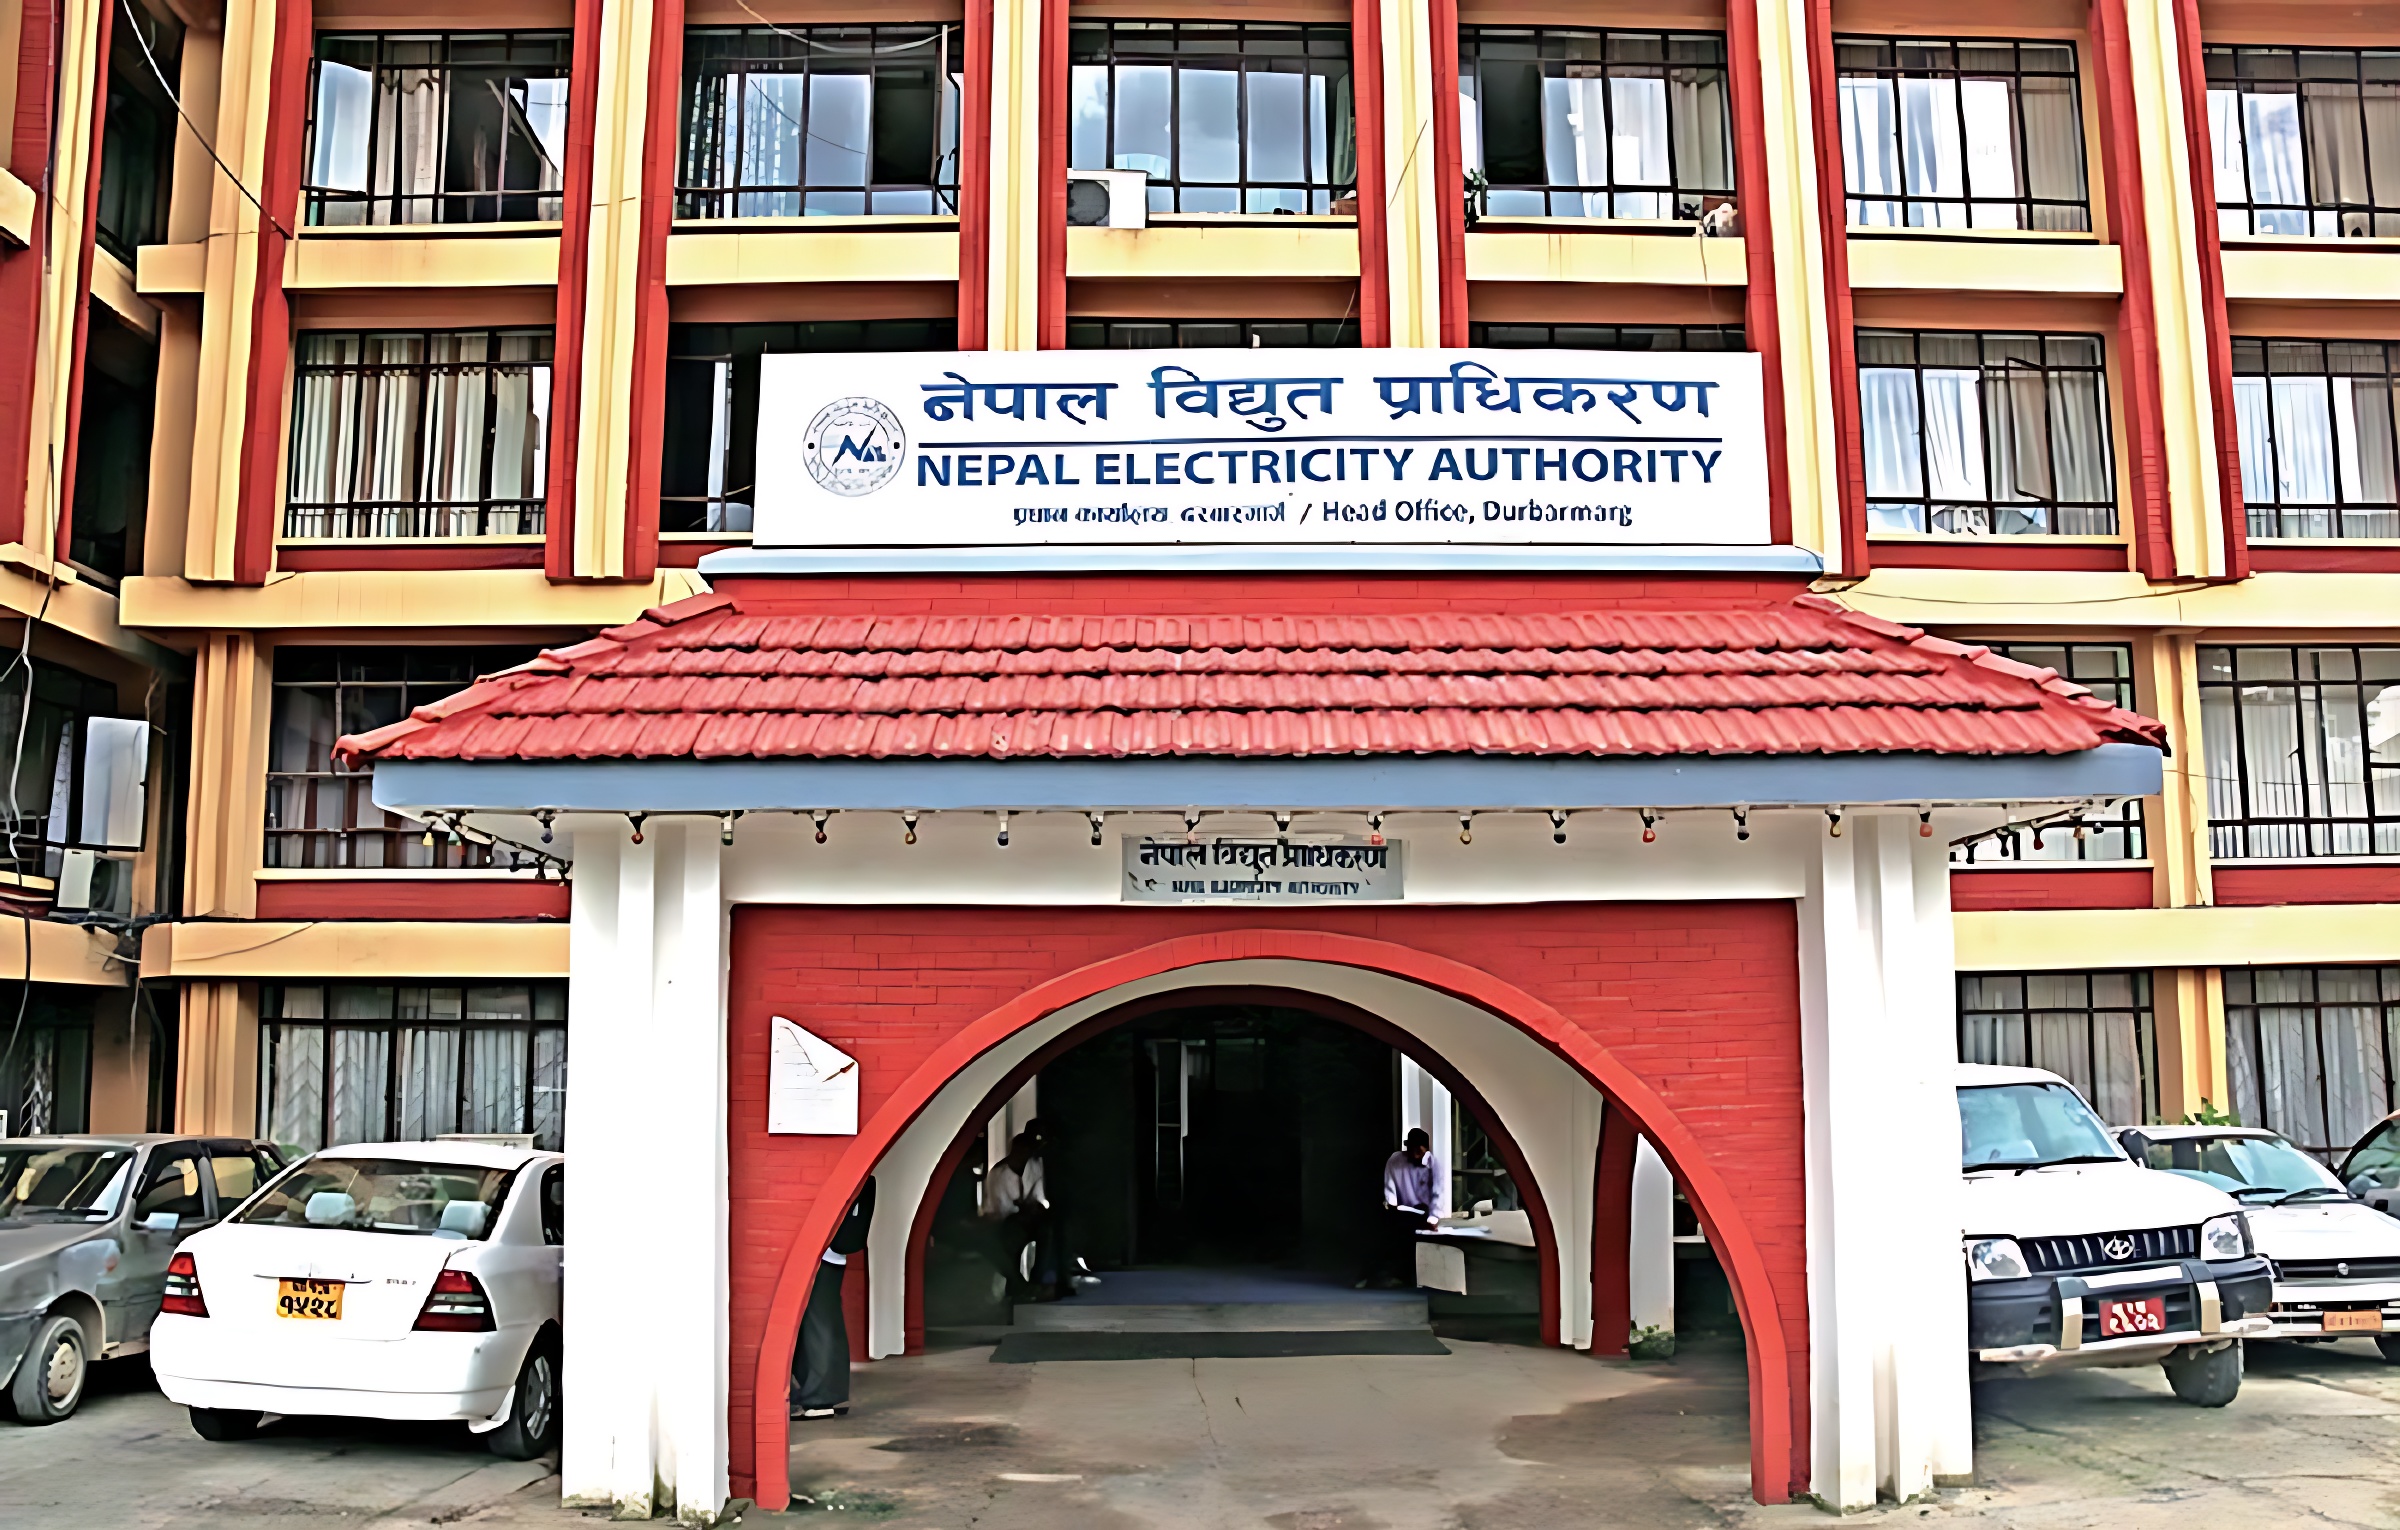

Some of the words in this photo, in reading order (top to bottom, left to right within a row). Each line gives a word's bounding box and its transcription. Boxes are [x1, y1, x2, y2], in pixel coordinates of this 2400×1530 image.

[919, 371, 1119, 426] नेपाल
[1146, 365, 1344, 433] विद्युत
[1372, 361, 1721, 425] प्राधिकरण
[917, 453, 1080, 487] NEPAL
[1095, 449, 1414, 486] ELECTRICITY
[1427, 448, 1723, 484] AUTHORITY
[1323, 499, 1387, 522] Head
[1395, 498, 1475, 525] Office,
[1483, 498, 1633, 527] Durbarmarg
[1139, 837, 1207, 870] नेपाल
